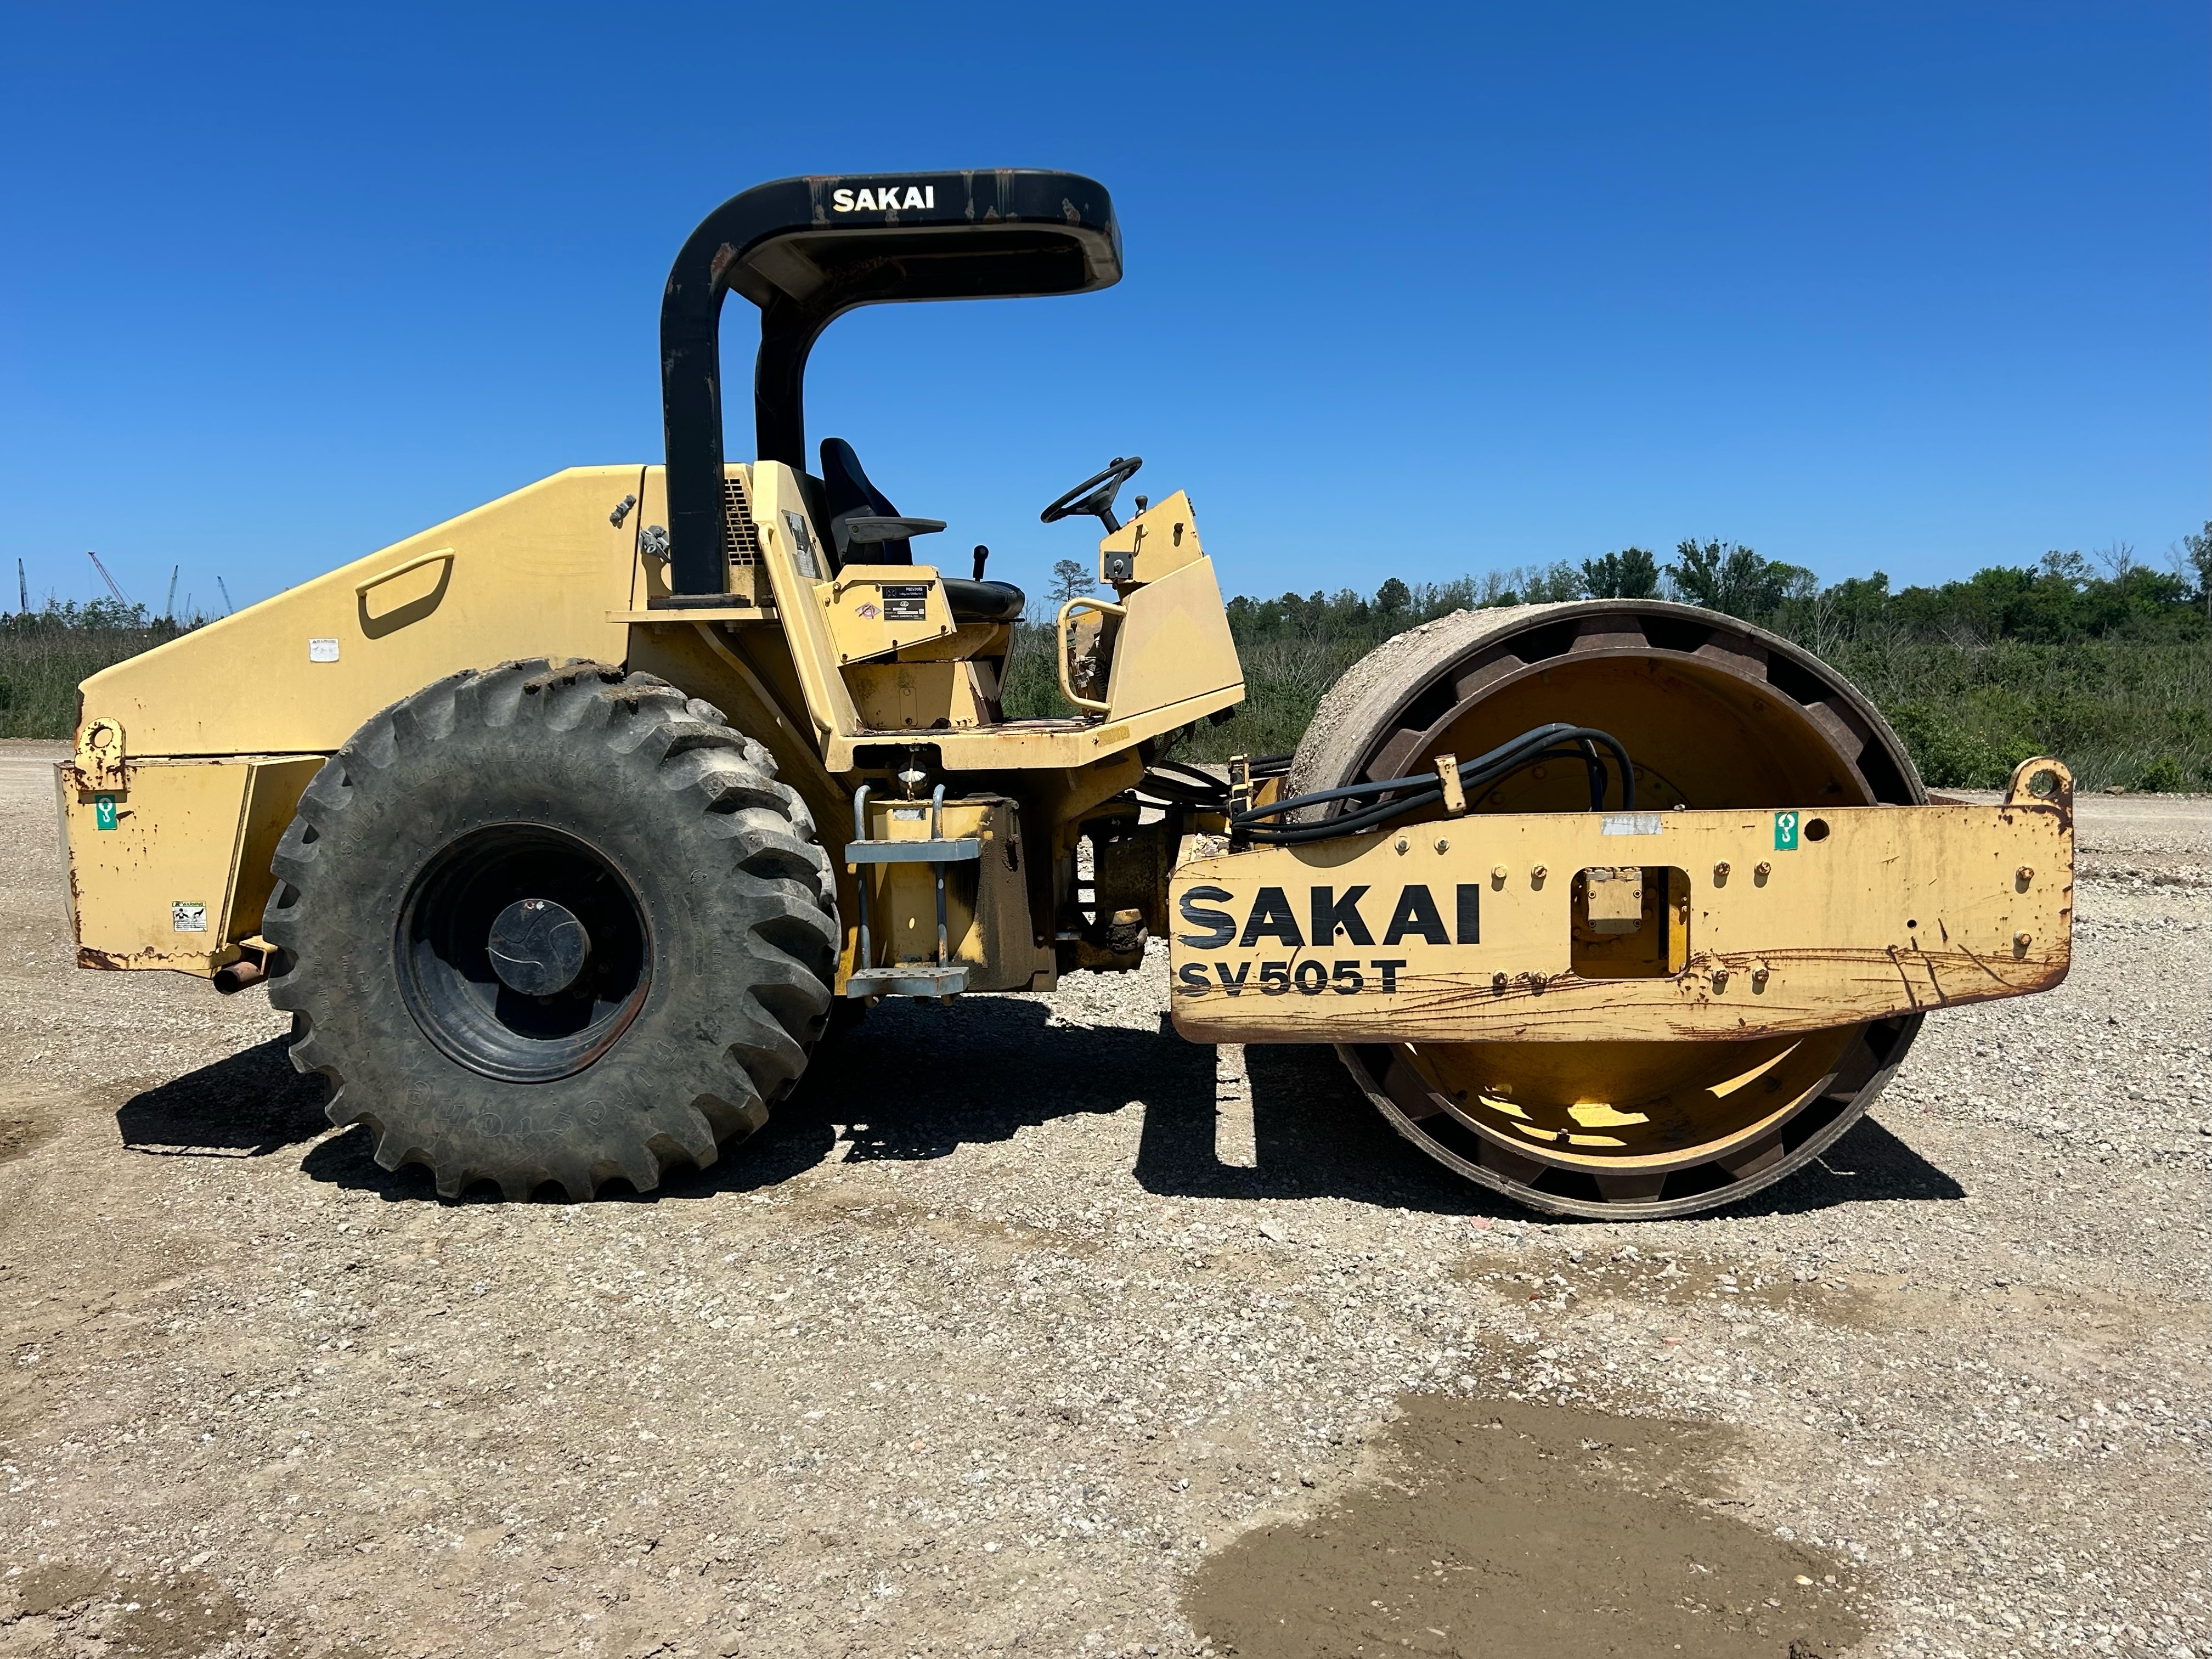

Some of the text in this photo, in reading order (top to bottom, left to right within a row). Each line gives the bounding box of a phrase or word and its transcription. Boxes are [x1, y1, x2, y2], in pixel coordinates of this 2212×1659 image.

[833, 185, 934, 212] SAKAI
[412, 757, 454, 788] ALL
[1177, 884, 1480, 950] SAKAI
[357, 970, 369, 993] R-1
[1177, 960, 1407, 997] SV505T
[406, 1040, 680, 1141] Firestone
